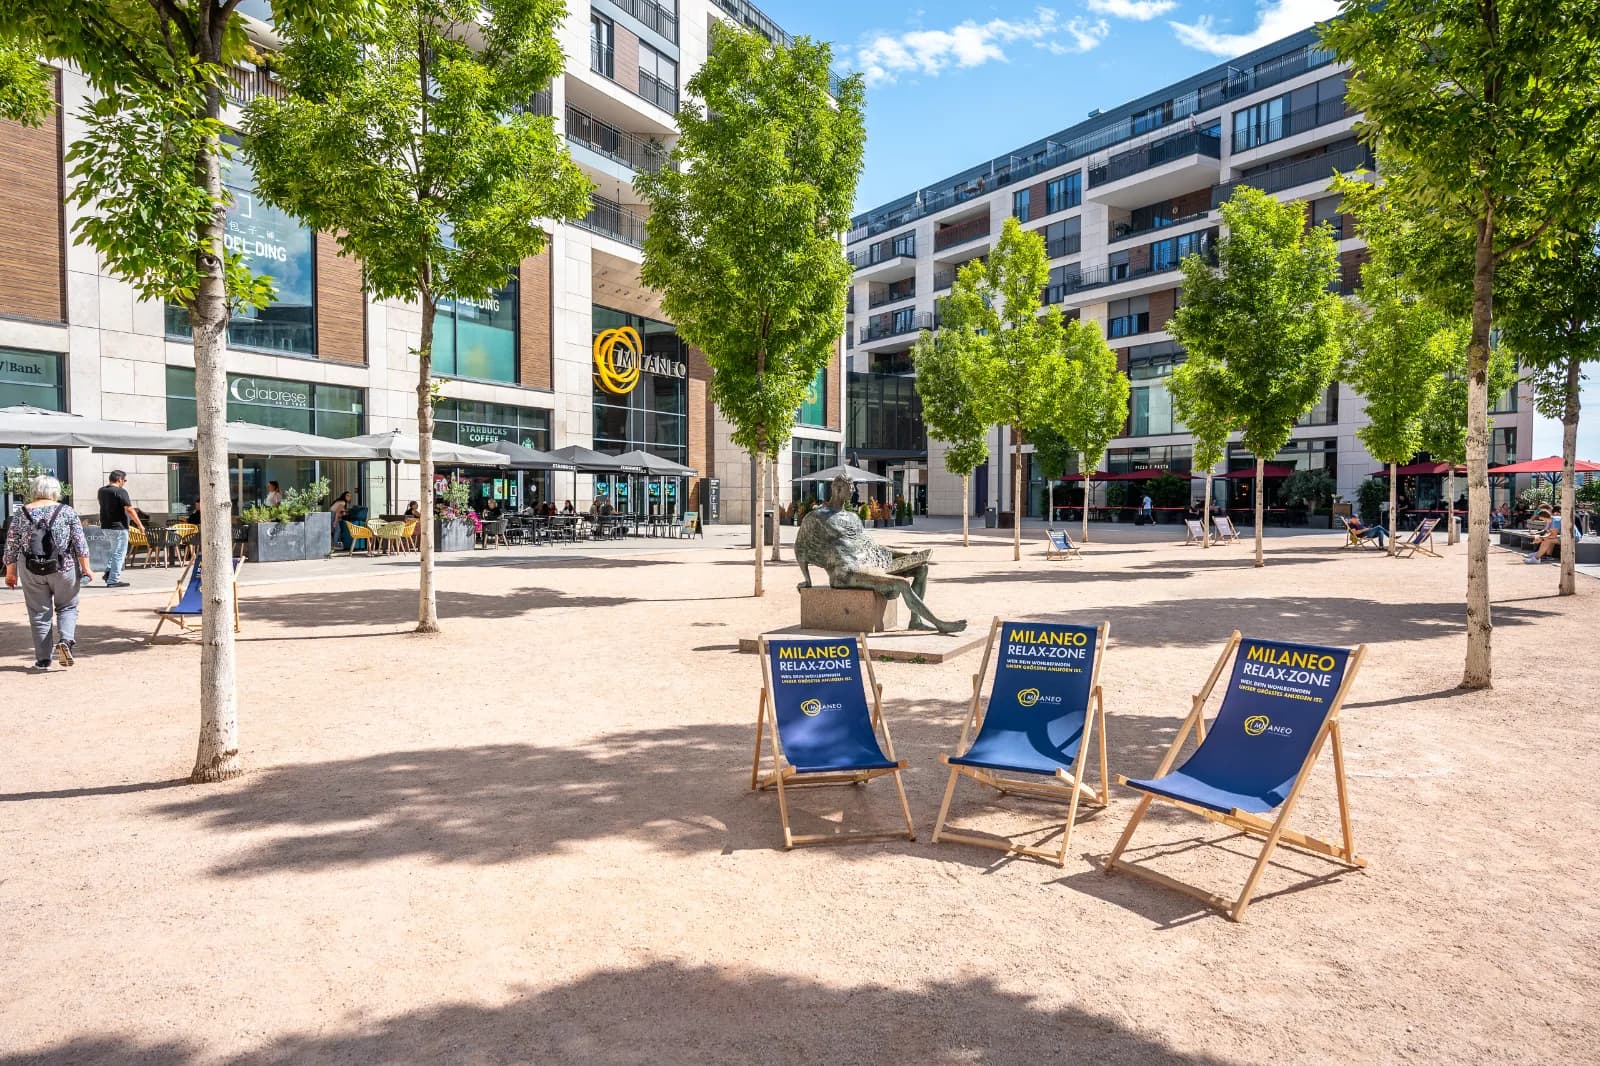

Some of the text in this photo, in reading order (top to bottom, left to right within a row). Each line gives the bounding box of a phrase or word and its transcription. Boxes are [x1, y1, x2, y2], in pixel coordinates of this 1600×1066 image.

[255, 240, 287, 262] DING
[230, 377, 306, 403] Calabrese
[460, 424, 507, 436] STARBUCKS
[469, 434, 499, 443] COFFEE
[1009, 629, 1087, 646] MILANEO
[779, 645, 850, 659] MILANEO
[1007, 644, 1086, 659] RELAX-ZONE
[1246, 645, 1336, 672] MILANEO
[779, 659, 852, 671] RELAX-ZONE
[1242, 662, 1332, 687] RELAX-ZONE
